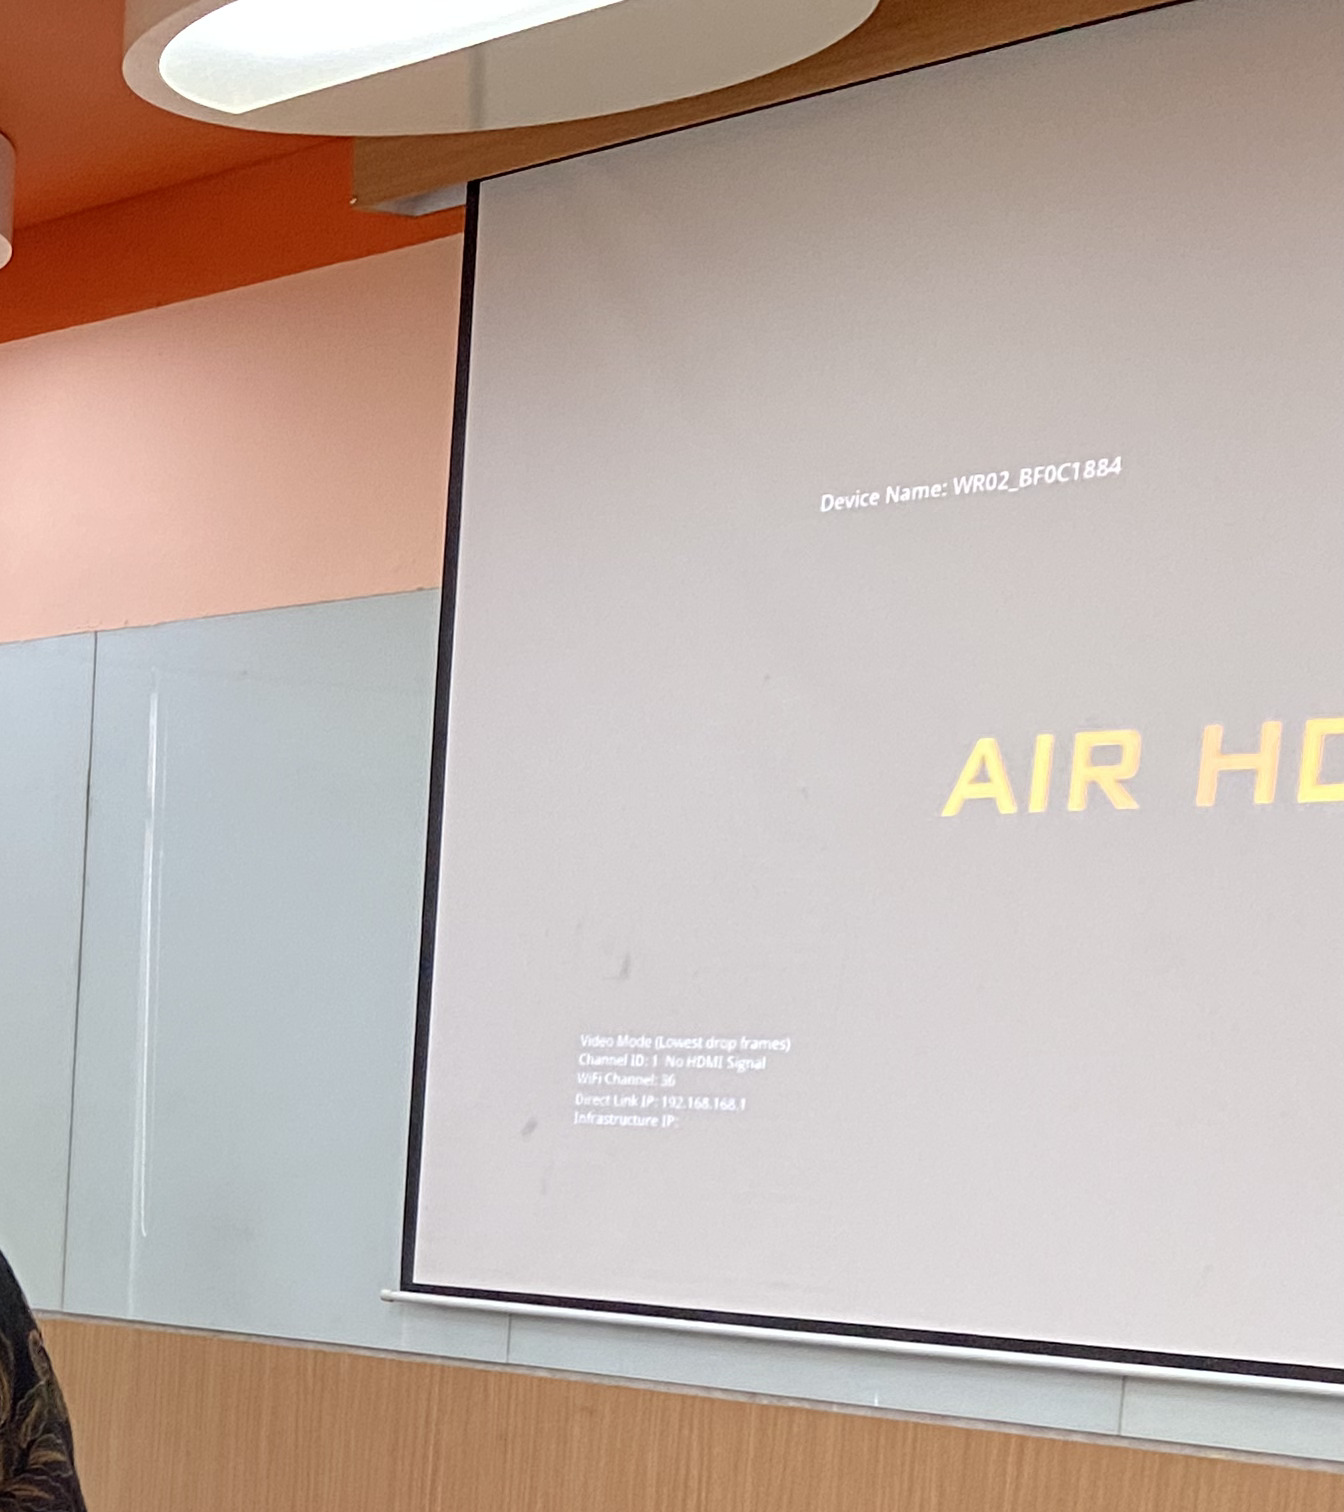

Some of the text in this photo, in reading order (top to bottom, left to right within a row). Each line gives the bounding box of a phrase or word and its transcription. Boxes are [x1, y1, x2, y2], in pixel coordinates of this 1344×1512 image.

[819, 456, 1123, 513] Device Name: WR02_BF0C1884
[940, 728, 1143, 818] AIR
[580, 1034, 792, 1053] Video Mode (Lowest drop frames)
[579, 1053, 767, 1073] Channel ID: 1 No HDMI Signal
[577, 1072, 602, 1086] WiFi
[605, 1072, 658, 1087] Channel:
[575, 1093, 747, 1111] Direct Link IP: 192.168.168.1
[574, 1111, 659, 1128] Infrastructure
